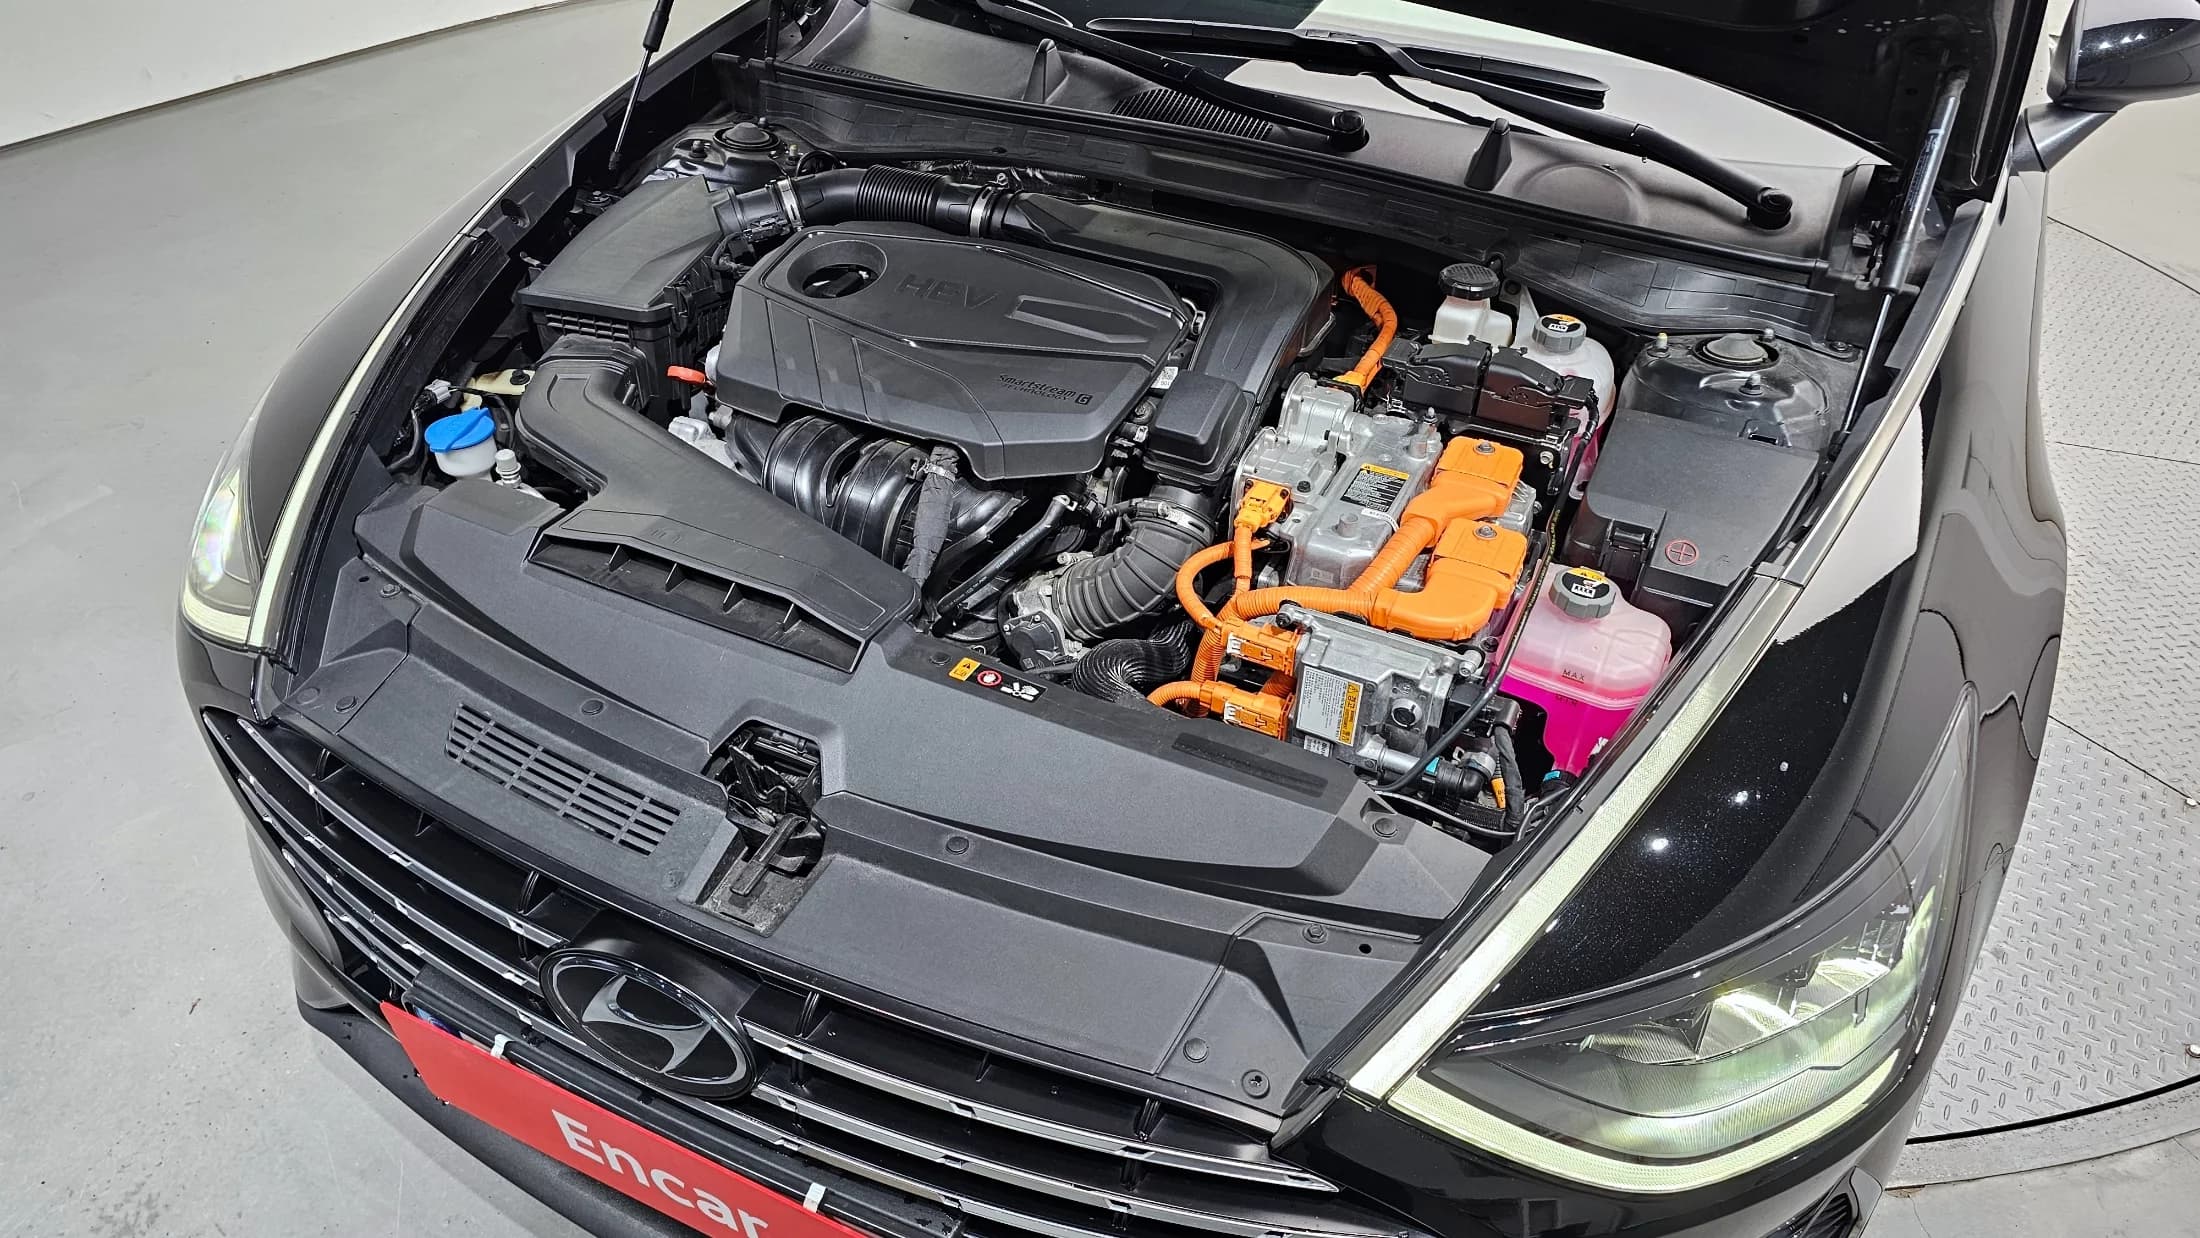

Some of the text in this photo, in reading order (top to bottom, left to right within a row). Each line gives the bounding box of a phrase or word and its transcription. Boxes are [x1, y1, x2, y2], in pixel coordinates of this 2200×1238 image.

[894, 273, 1000, 311] HEV
[999, 374, 1077, 398] Smartstream
[1562, 669, 1585, 681] MAX
[551, 1108, 769, 1238] Encar
